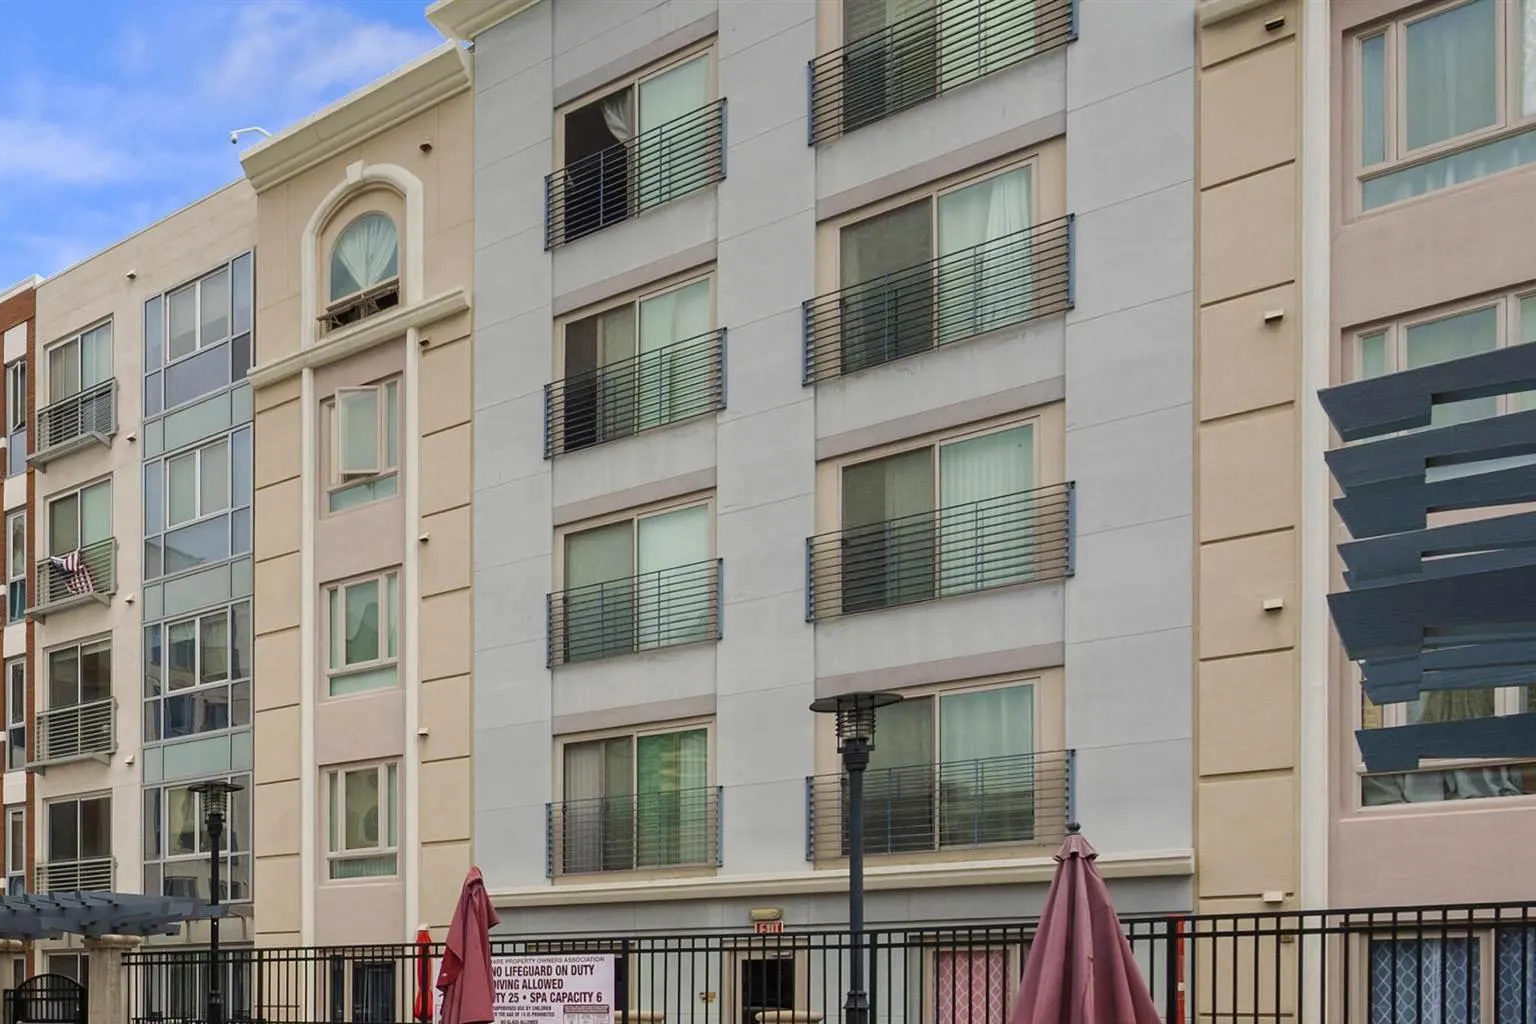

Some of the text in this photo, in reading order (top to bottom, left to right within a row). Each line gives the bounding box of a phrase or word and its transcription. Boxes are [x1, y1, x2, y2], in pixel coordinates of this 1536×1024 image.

[505, 965, 553, 977] LIFEGUARD
[555, 965, 568, 976] ON
[571, 964, 595, 976] DUTY
[521, 978, 564, 990] ALLOWED
[508, 992, 519, 1003] 25
[530, 992, 547, 1003] SPA
[550, 991, 594, 1003] CAPACITY
[596, 991, 603, 1003] 6
